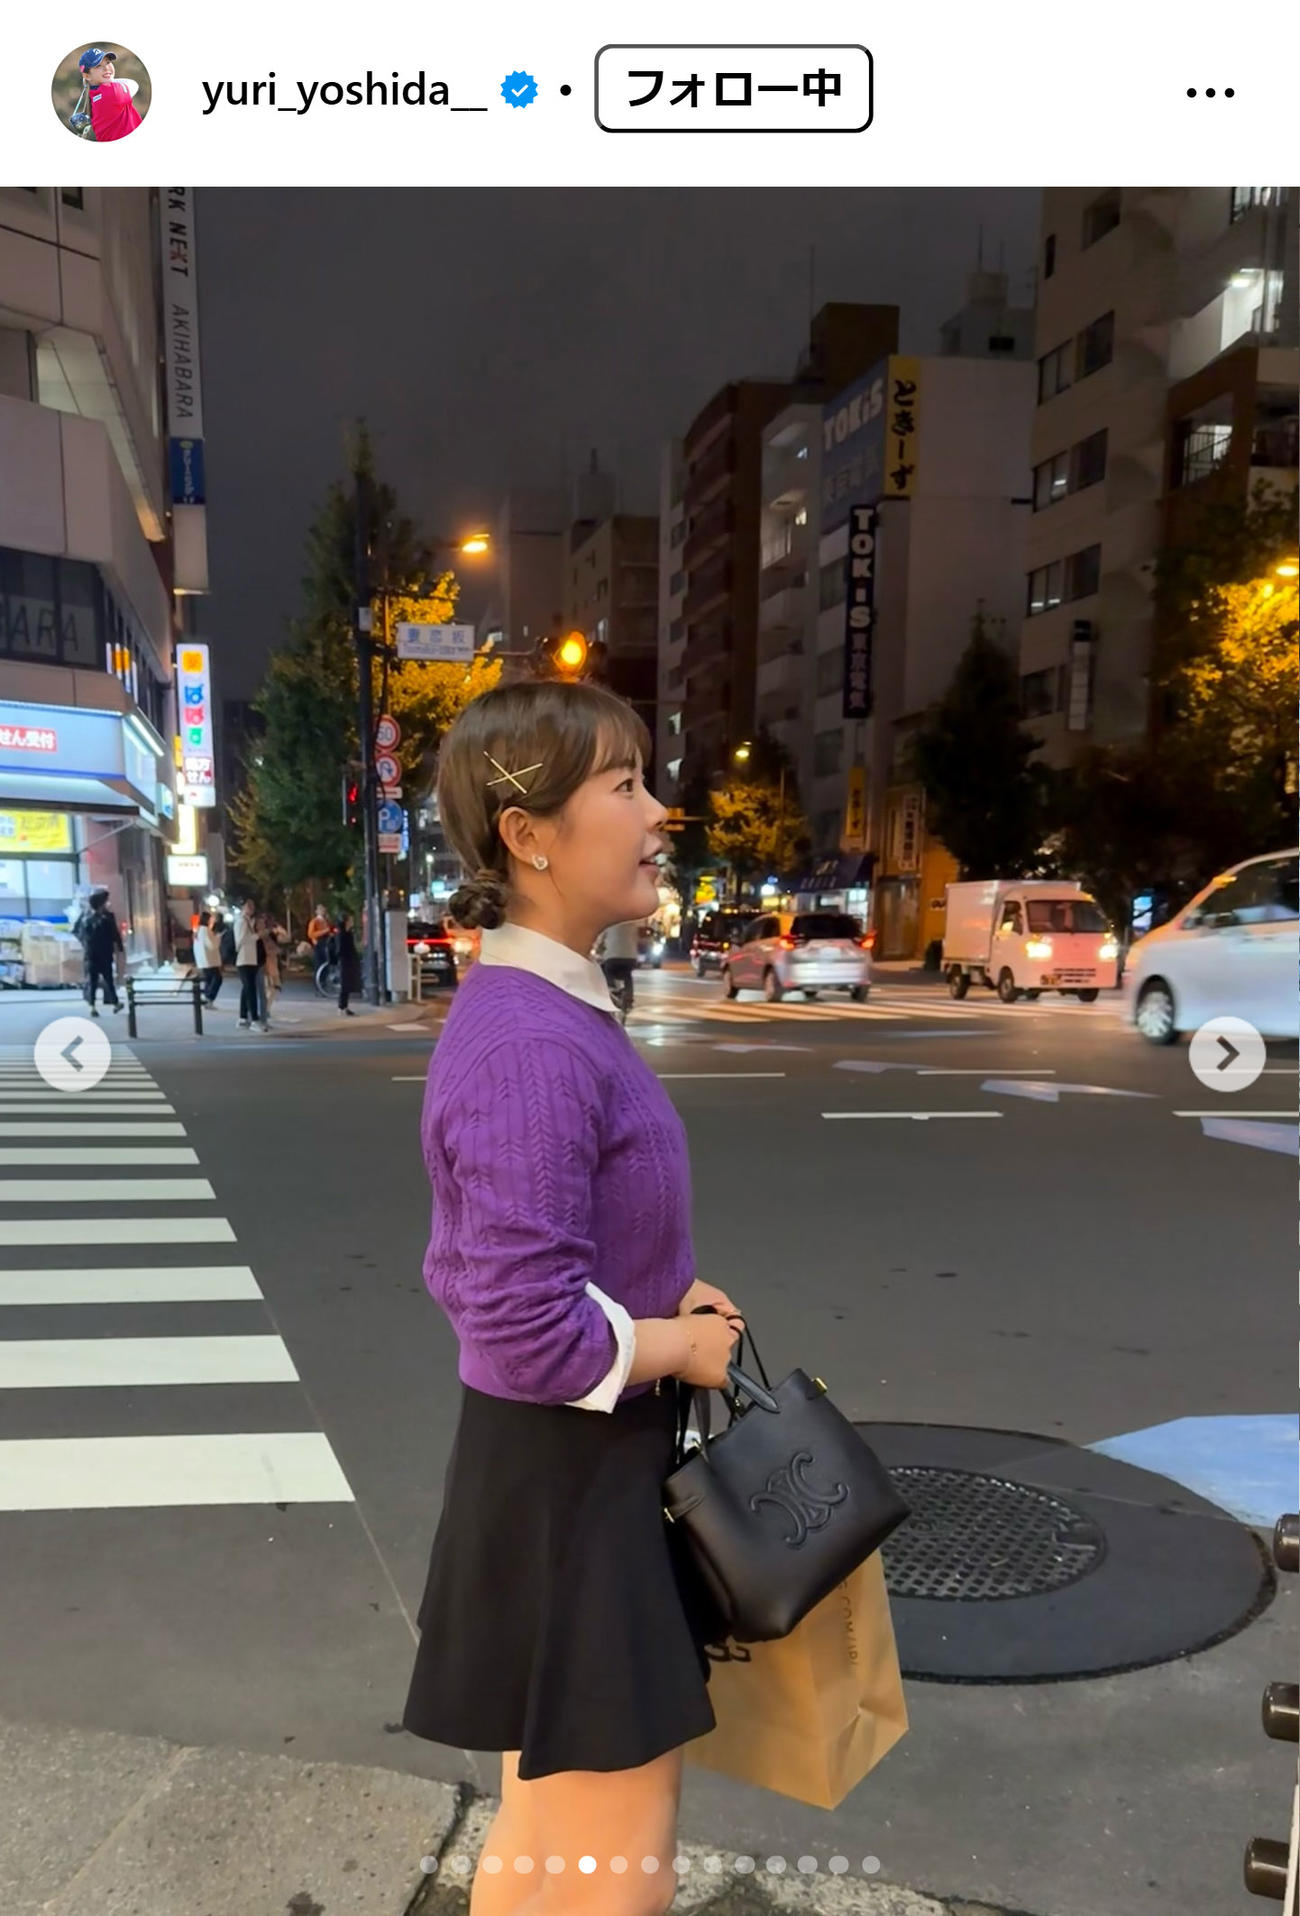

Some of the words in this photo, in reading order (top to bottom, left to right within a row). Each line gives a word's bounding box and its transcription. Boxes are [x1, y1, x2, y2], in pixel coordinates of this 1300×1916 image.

[169, 222, 190, 278] NEXT
[171, 303, 194, 418] AKIHABARA
[889, 379, 917, 489] ときーず
